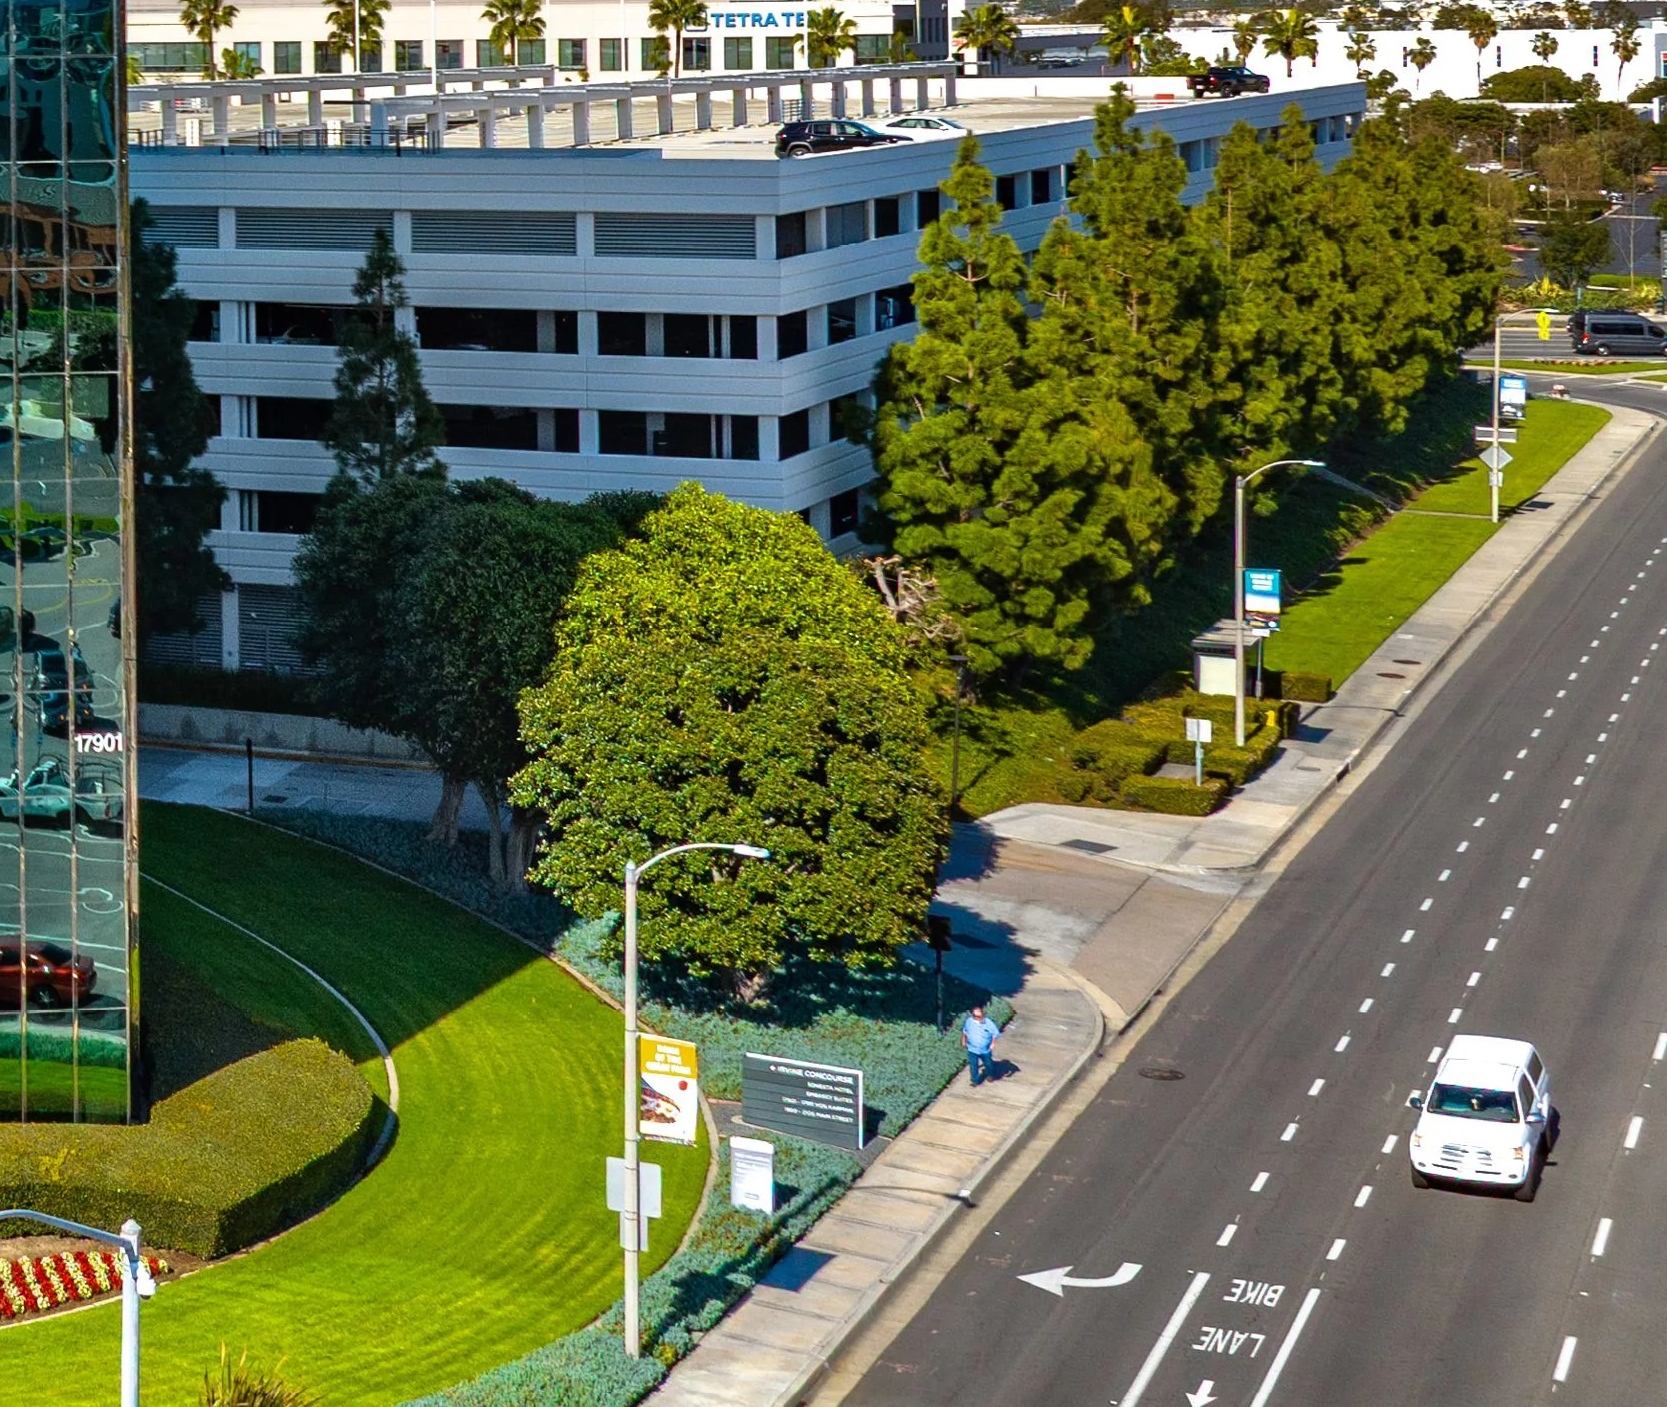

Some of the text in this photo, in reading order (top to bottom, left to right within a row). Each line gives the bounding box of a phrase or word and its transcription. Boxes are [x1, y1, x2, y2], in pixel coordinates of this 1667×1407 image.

[710, 12, 805, 28] TETRA TE
[74, 732, 123, 753] 17901
[804, 1070, 854, 1085] CONCOURSE
[1223, 1278, 1286, 1307] BIKE
[1192, 1326, 1266, 1358] LANE
